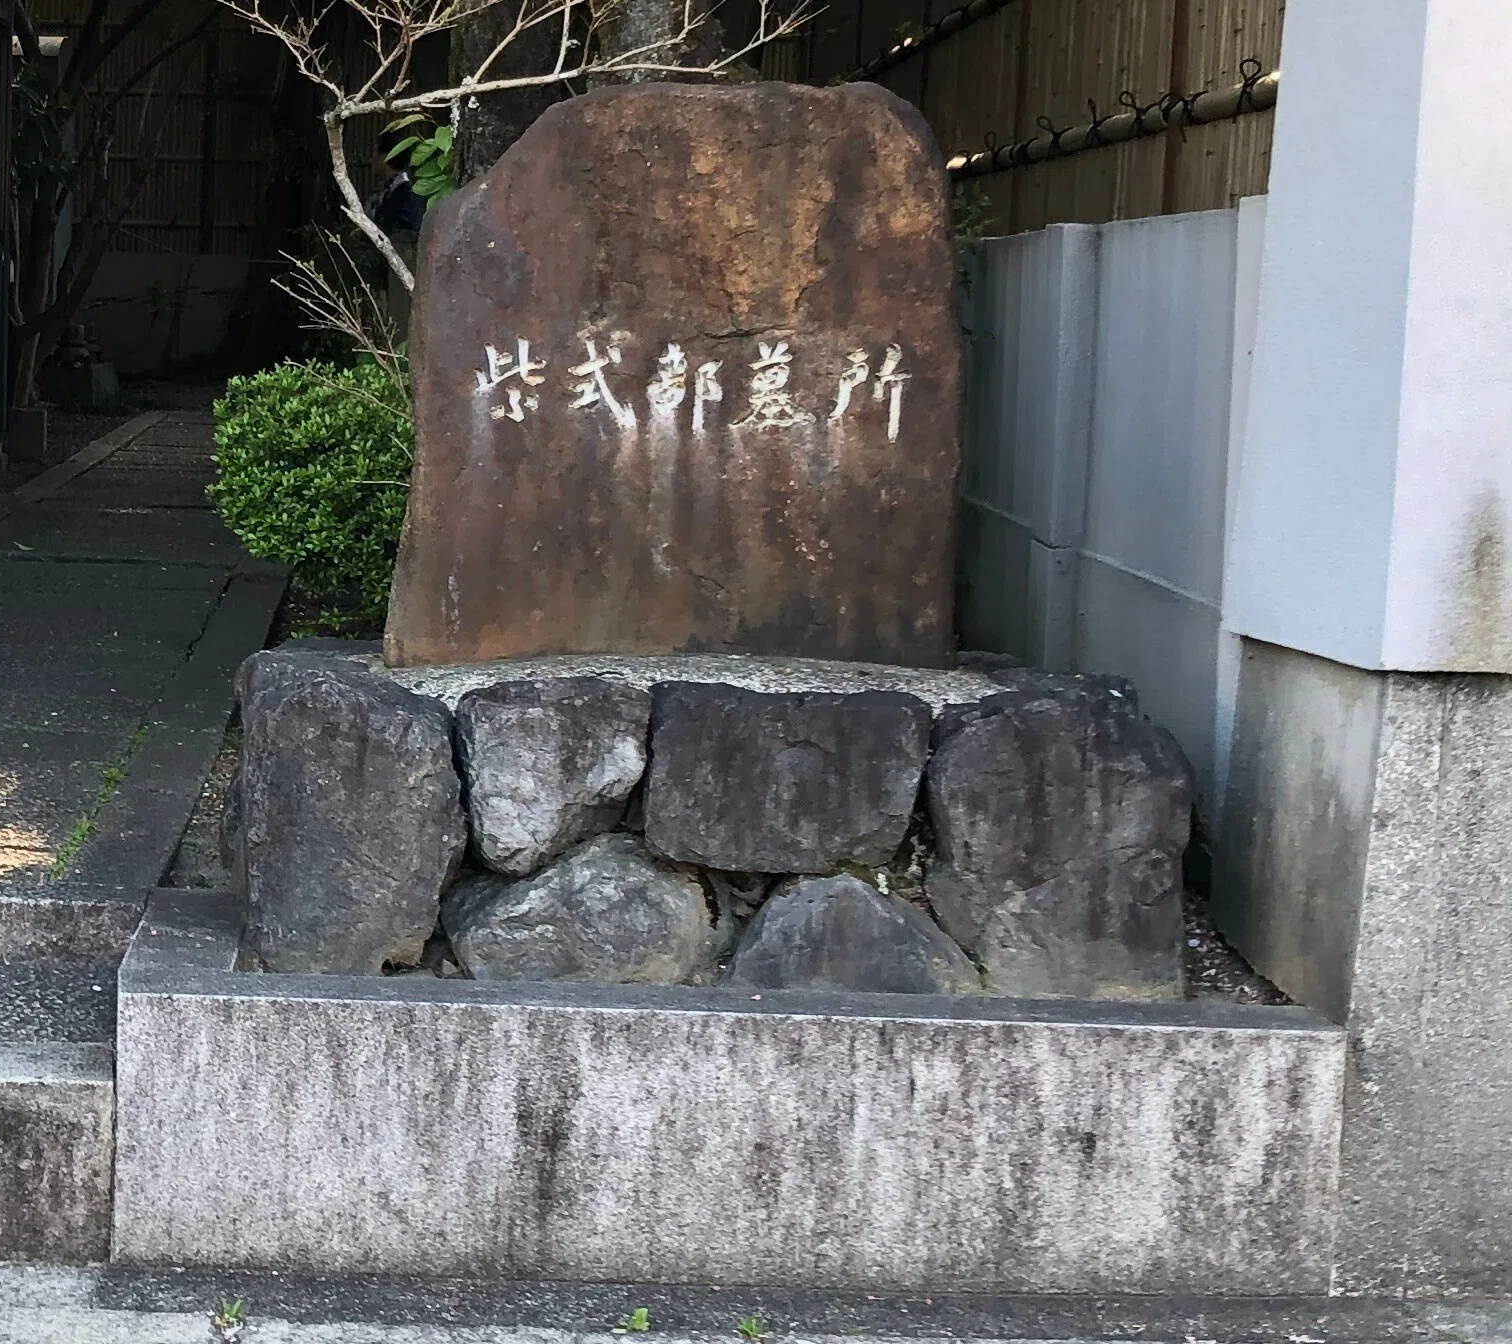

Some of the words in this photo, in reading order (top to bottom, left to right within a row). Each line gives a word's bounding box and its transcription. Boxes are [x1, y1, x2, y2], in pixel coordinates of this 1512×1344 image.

[473, 336, 911, 443] 紫式部墓所
